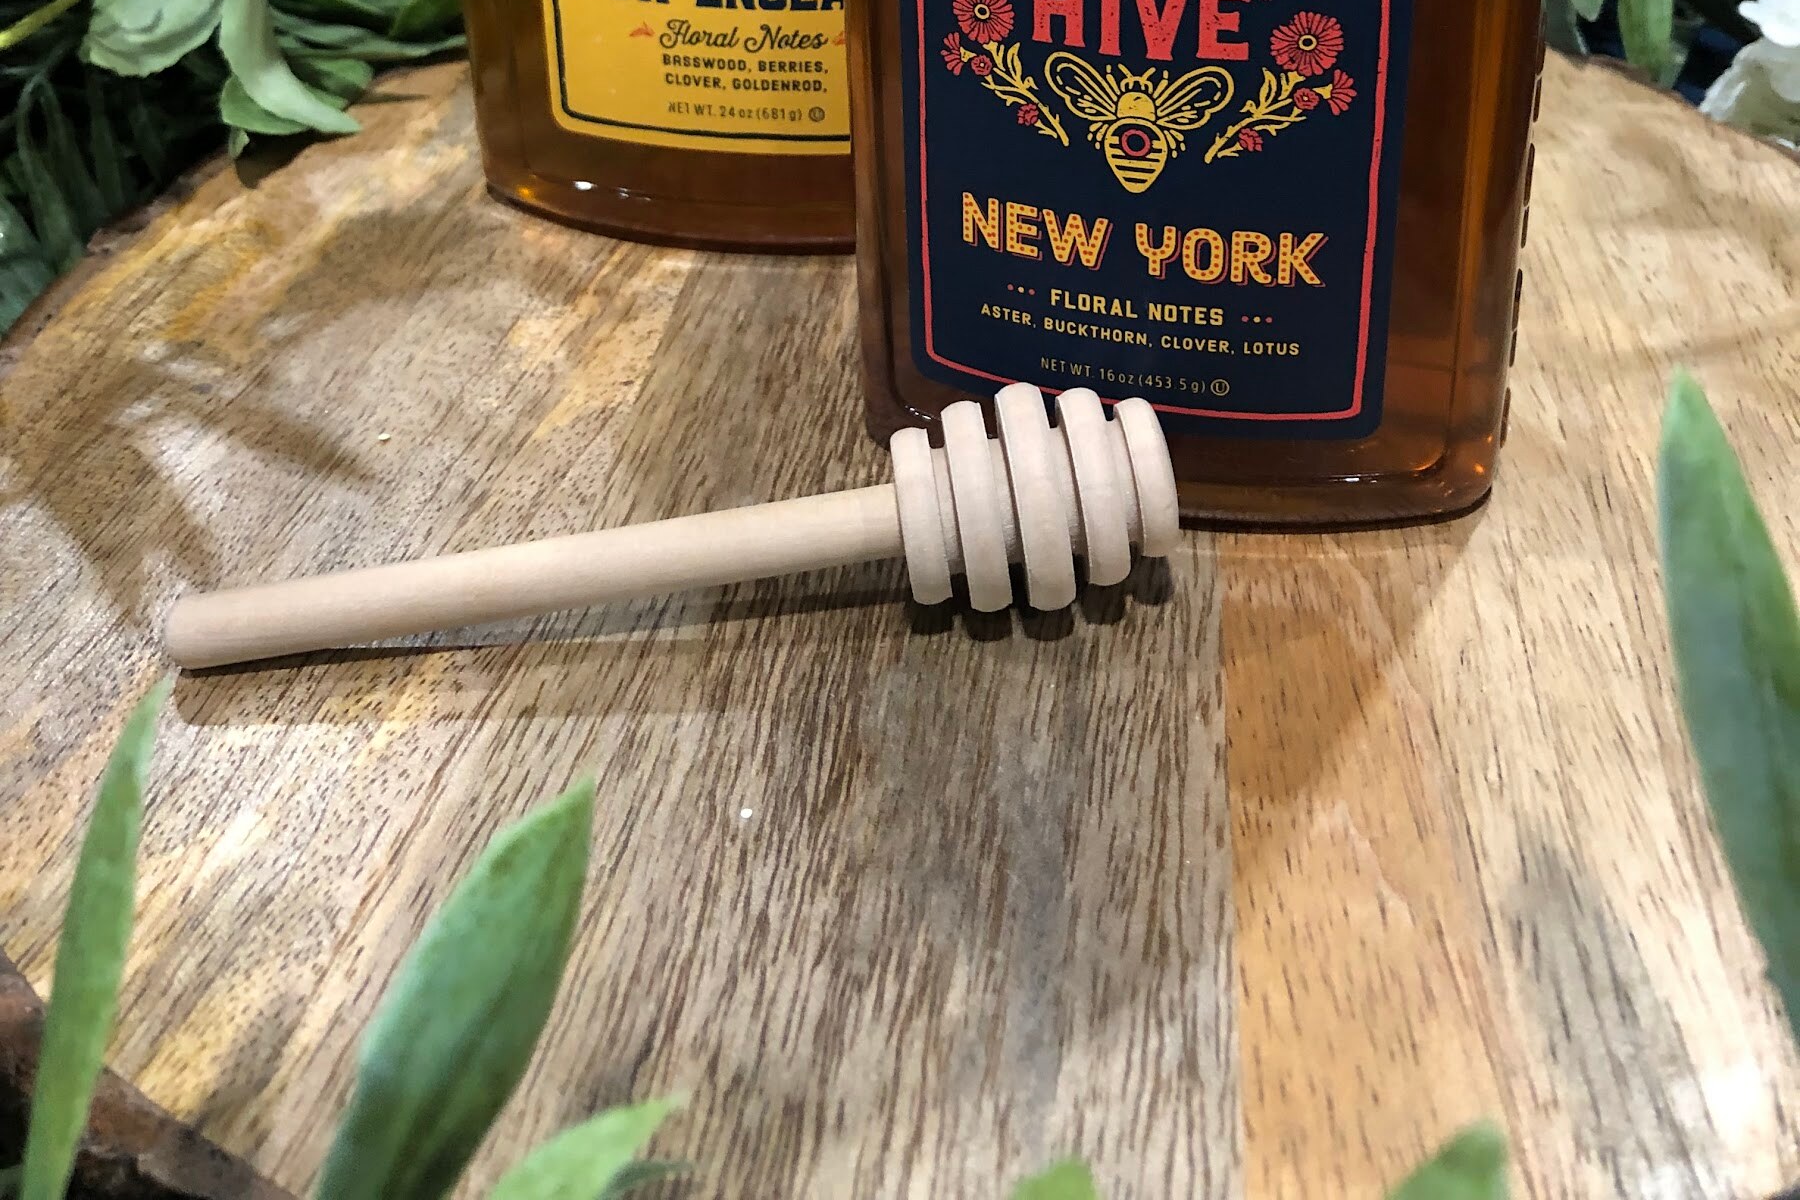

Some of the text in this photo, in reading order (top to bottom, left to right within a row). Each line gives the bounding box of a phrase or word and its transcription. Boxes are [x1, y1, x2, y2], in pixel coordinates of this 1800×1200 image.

[659, 18, 829, 54] Floral Notes
[662, 53, 829, 74] BASSWOOD, BERRIES,
[665, 73, 828, 93] CLOVER, GOLDENROD,
[668, 101, 690, 114] NET
[961, 191, 1329, 288] NEW YORK
[1049, 288, 1225, 326] FLORAL NOTES
[980, 303, 1301, 357] ASTER, BUCKTHORN, CLOVER, LOTUS
[1040, 356, 1066, 373] NET
